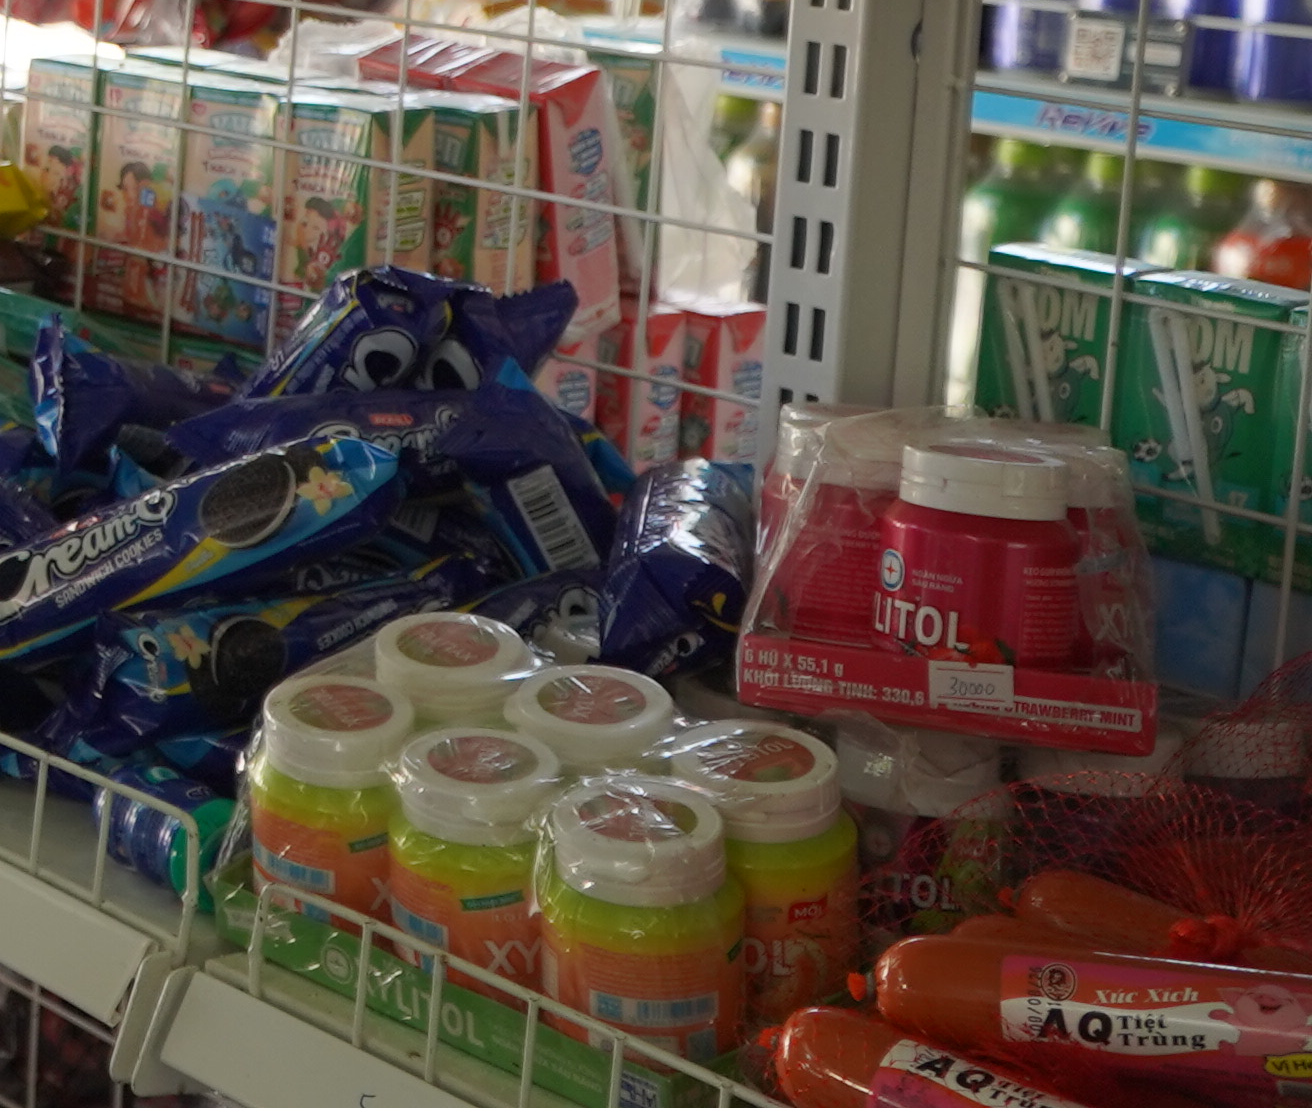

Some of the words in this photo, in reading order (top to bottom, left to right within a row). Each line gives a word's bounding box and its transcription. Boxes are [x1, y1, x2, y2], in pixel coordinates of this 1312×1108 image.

[55, 560, 114, 609] SANDWICH
[114, 528, 164, 569] COOKIES
[875, 591, 971, 649] LITOL
[744, 648, 754, 663] 6
[783, 653, 794, 668] X
[796, 655, 829, 674] 55,1
[881, 686, 925, 707] 330,6
[1099, 712, 1136, 728] MINT
[1093, 988, 1139, 1005] Xúc
[1143, 986, 1200, 1004] Xích
[1116, 1031, 1207, 1051] Trùng
